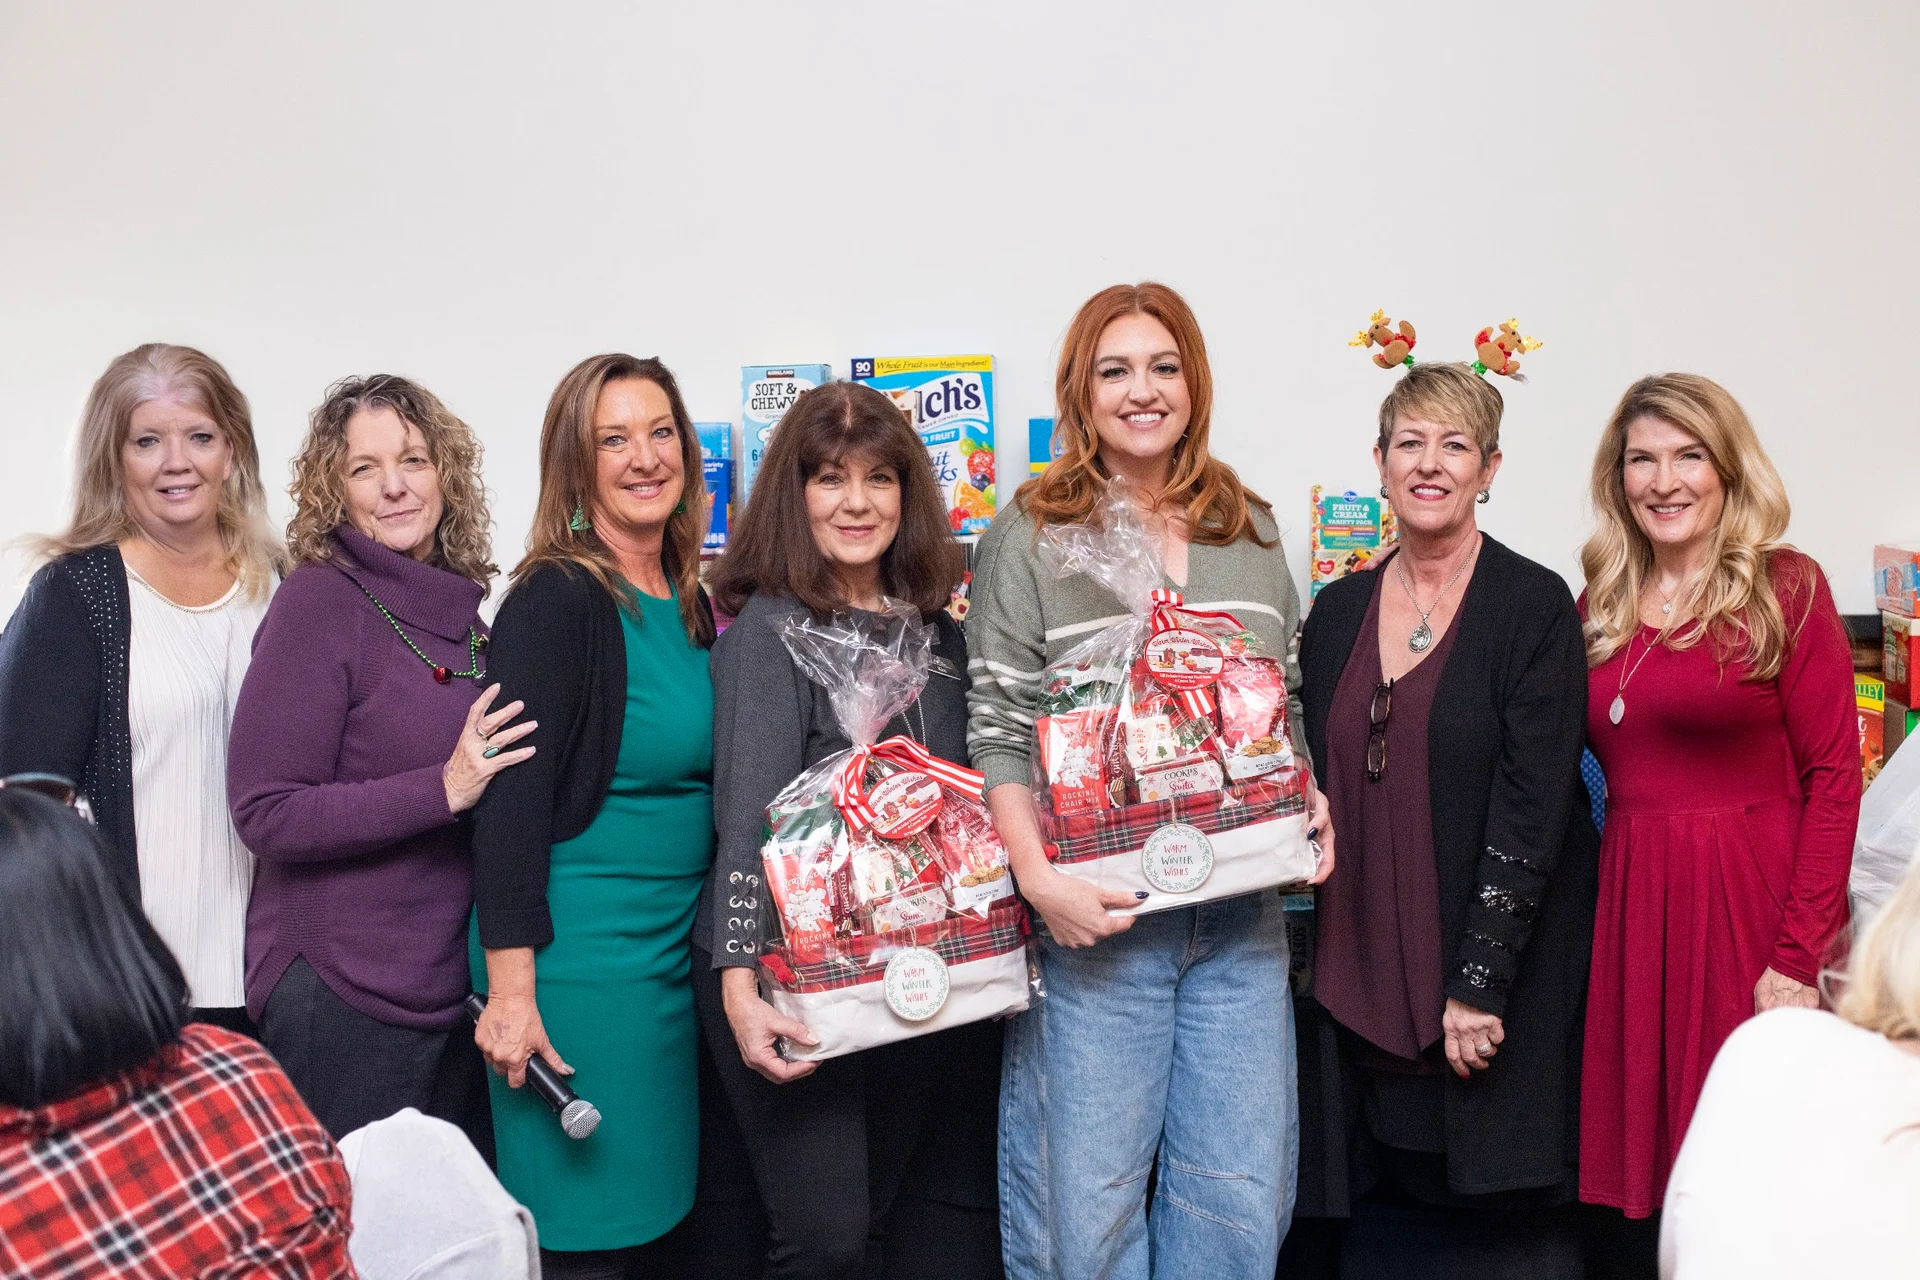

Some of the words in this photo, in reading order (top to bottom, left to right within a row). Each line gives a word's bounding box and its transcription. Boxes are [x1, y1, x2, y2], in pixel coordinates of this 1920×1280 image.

[855, 362, 870, 373] 90
[876, 361, 901, 369] Whole
[903, 360, 923, 368] Fruit
[755, 383, 783, 396] SOFT
[786, 383, 797, 394] &
[751, 397, 796, 410] CHEWY
[917, 377, 982, 424] lch's
[930, 430, 957, 442] FRUIT
[1332, 511, 1367, 519] CREAM
[1855, 683, 1880, 700] ALLEY
[1164, 767, 1199, 780] COOKIES
[1168, 780, 1196, 793] Santa
[1062, 788, 1095, 800] ROCKING
[1060, 799, 1083, 809] CHAIR
[1085, 796, 1100, 804] MIX
[1164, 843, 1187, 854] WARM
[1161, 854, 1194, 865] WINTER
[1164, 866, 1189, 877] WISHES
[799, 931, 831, 945] ROCKING
[903, 966, 925, 978] WARM
[901, 978, 932, 991] WINTER
[905, 991, 928, 1003] WISHES
